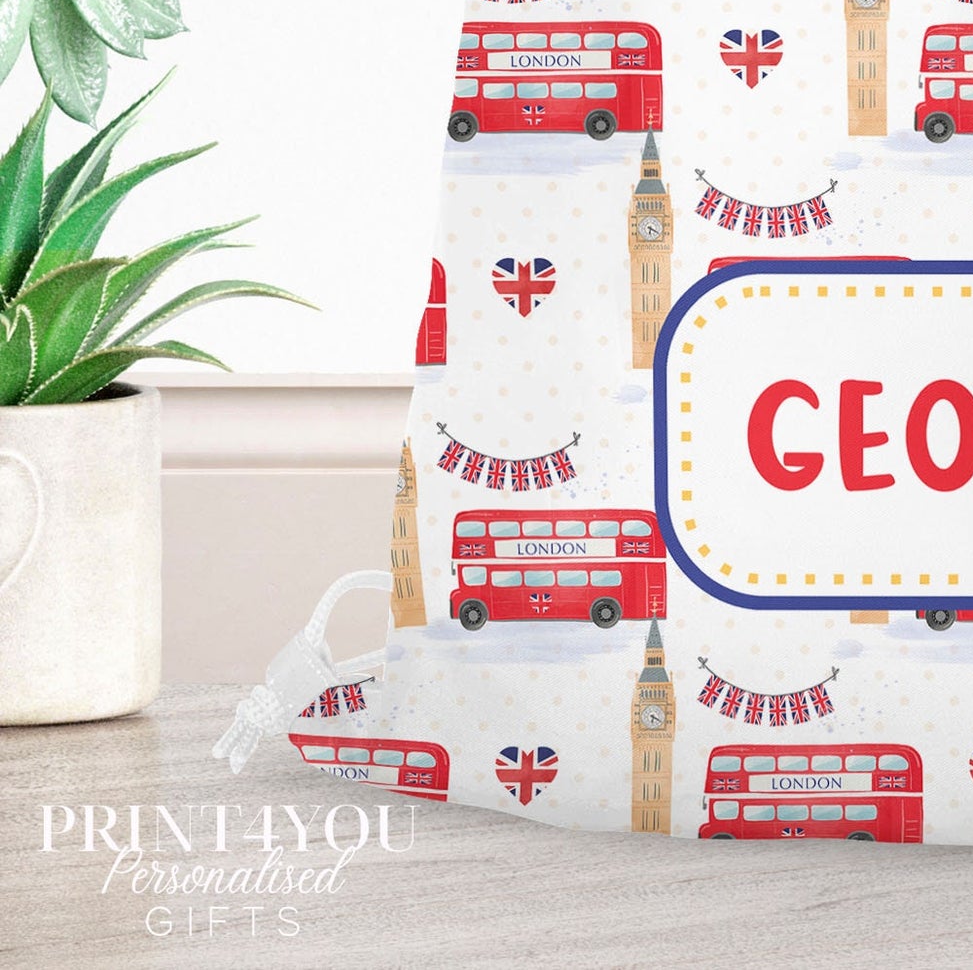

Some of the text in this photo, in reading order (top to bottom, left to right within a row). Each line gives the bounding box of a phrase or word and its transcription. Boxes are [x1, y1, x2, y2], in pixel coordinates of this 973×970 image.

[510, 53, 582, 68] LONDON
[515, 542, 587, 555] LONDON
[772, 777, 842, 790] LONDON
